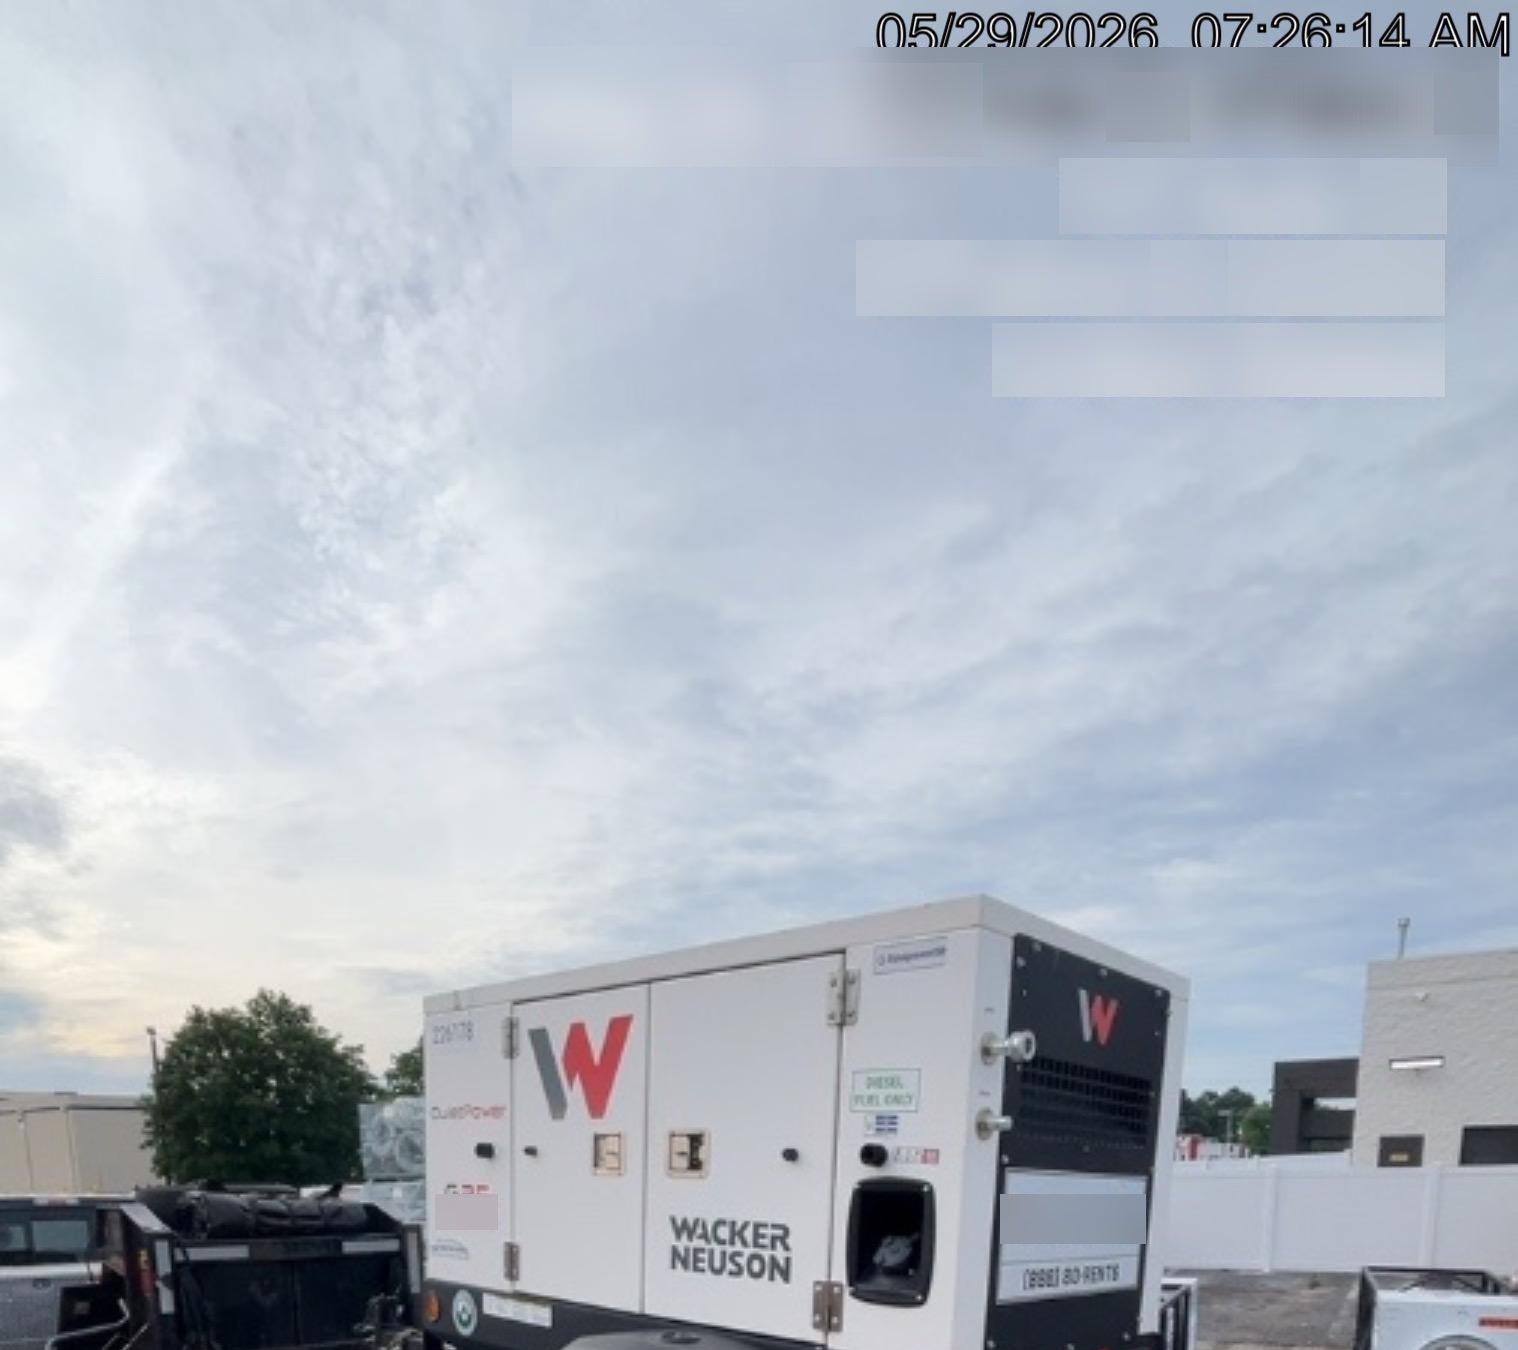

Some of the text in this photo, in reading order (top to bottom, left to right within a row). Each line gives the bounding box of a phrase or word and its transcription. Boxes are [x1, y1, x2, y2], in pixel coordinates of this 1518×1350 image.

[884, 1093, 913, 1105] ONLY
[669, 1215, 791, 1252] WACKER
[670, 1245, 791, 1284] NEUSON
